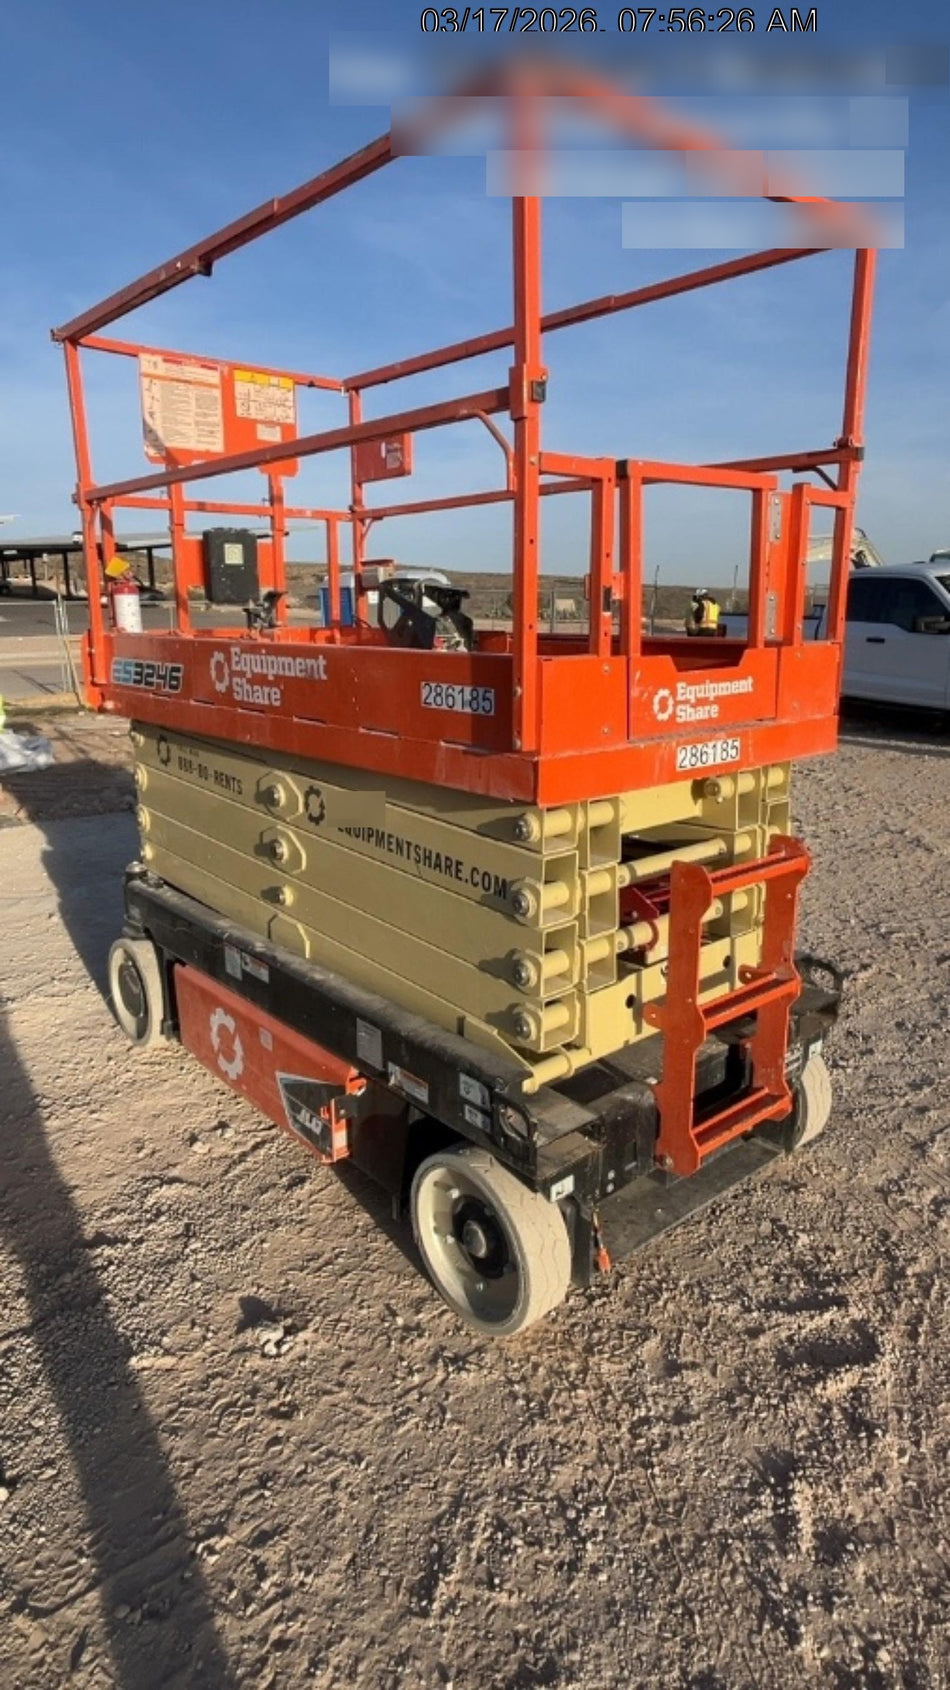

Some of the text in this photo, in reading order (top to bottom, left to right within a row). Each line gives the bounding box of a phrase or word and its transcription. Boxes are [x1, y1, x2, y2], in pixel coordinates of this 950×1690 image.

[230, 647, 328, 680] Equipment
[232, 676, 282, 706] Share
[422, 682, 493, 714] 286185
[676, 677, 753, 702] Equipment
[676, 703, 719, 722] Share
[678, 739, 739, 769] 286185
[337, 827, 508, 900] QUIPMENTSHARE.COM
